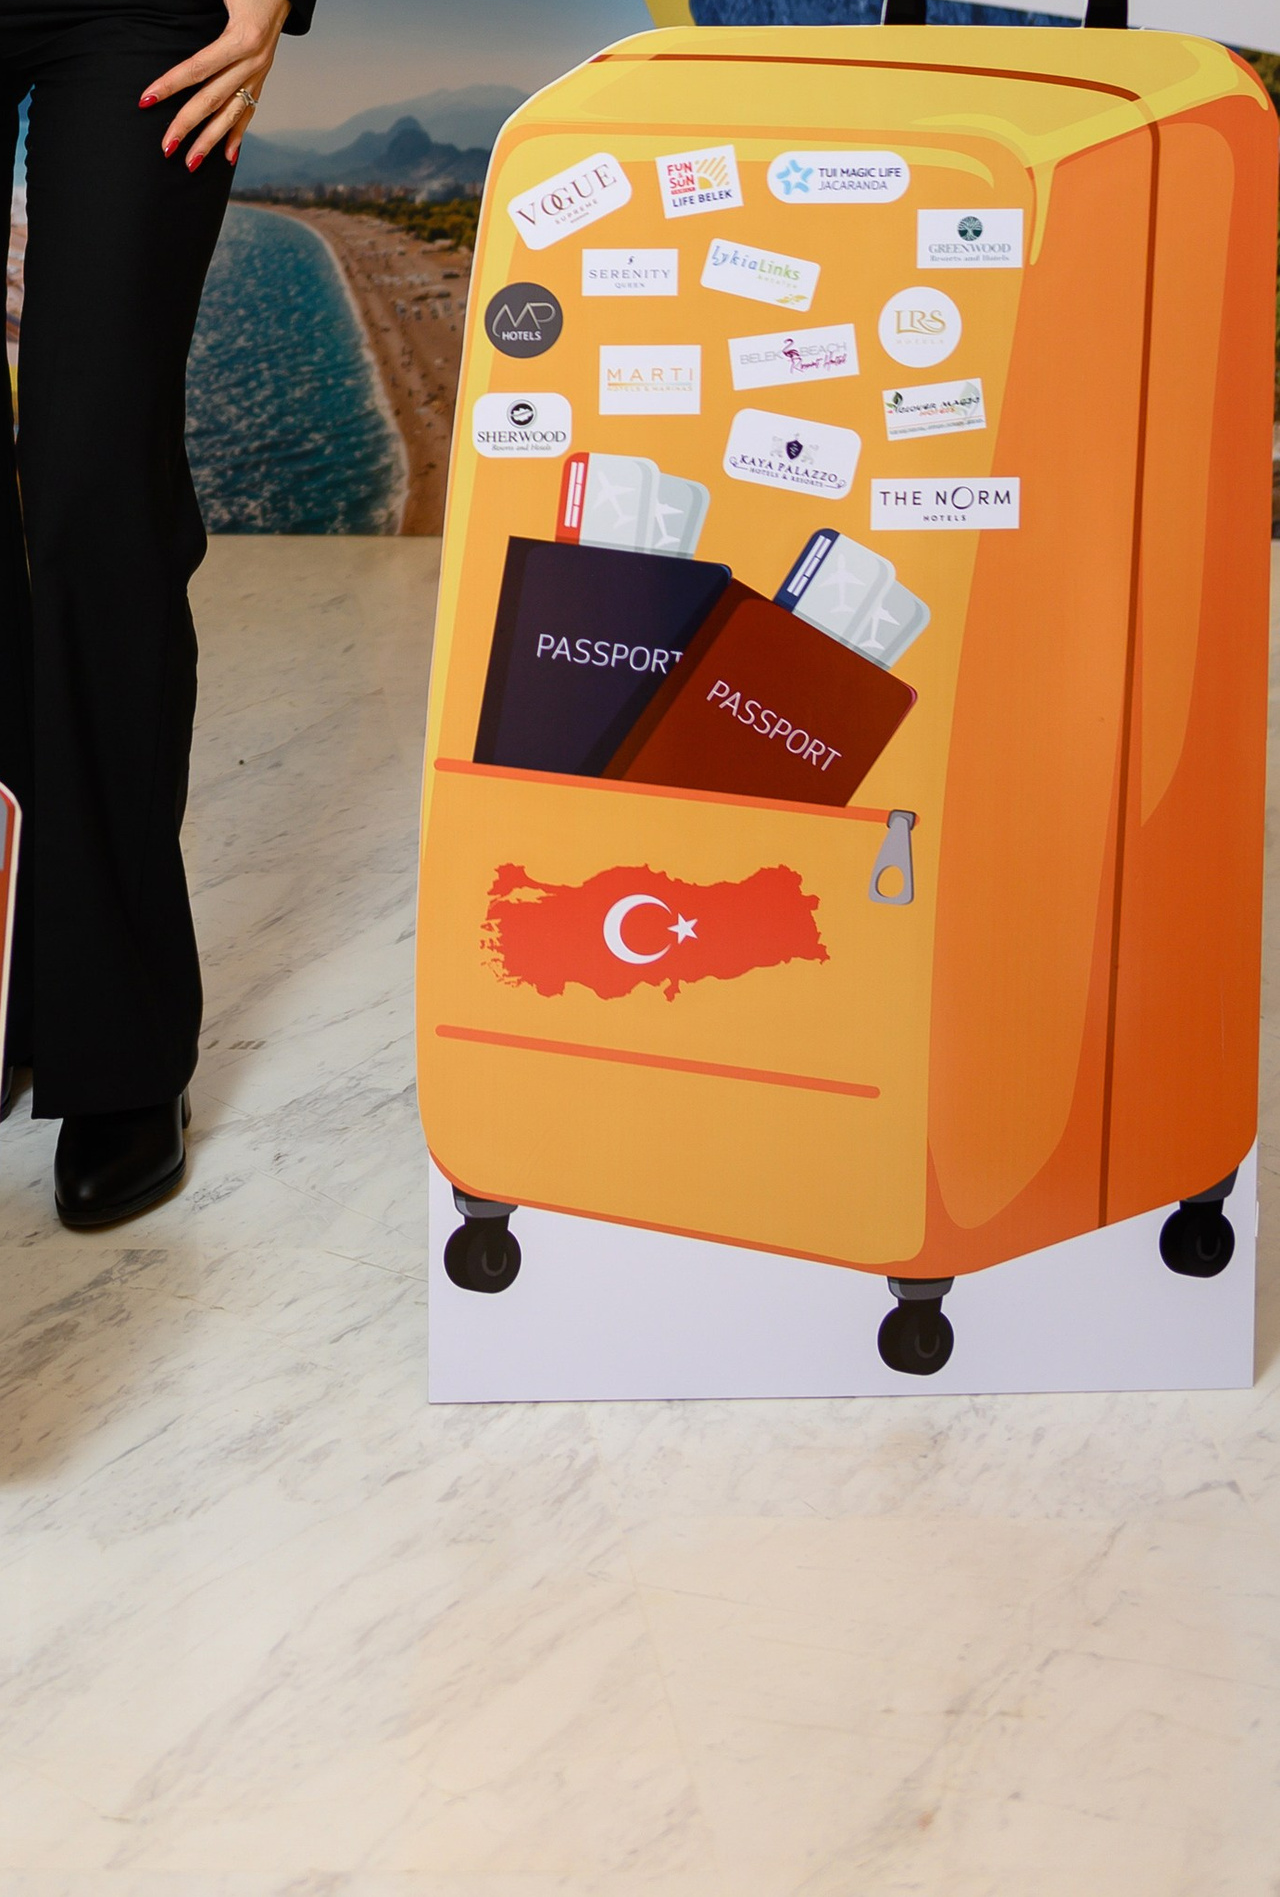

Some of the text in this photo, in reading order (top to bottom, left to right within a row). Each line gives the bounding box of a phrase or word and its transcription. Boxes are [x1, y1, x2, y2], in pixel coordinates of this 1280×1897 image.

[666, 161, 693, 176] FUN
[818, 167, 902, 178] TUI MAGIC LIFE
[669, 175, 695, 189] SUN
[818, 180, 889, 191] JACARANDA
[516, 163, 617, 226] VOGUE
[672, 195, 695, 208] LIFE
[698, 189, 733, 203] BELEK
[928, 243, 1012, 254] GREENWOOD
[588, 268, 671, 279] SERENITY
[894, 309, 947, 336] LRS
[501, 330, 543, 341] HOTELS
[740, 341, 848, 365] BELEK BEACH
[606, 367, 694, 382] MARTI
[477, 430, 567, 443] SHERWOOD
[739, 454, 839, 484] KAYA PALAZZO
[879, 485, 1012, 510] THE NORM
[922, 514, 968, 522] HOTELS
[705, 679, 843, 773] PASSPORT
